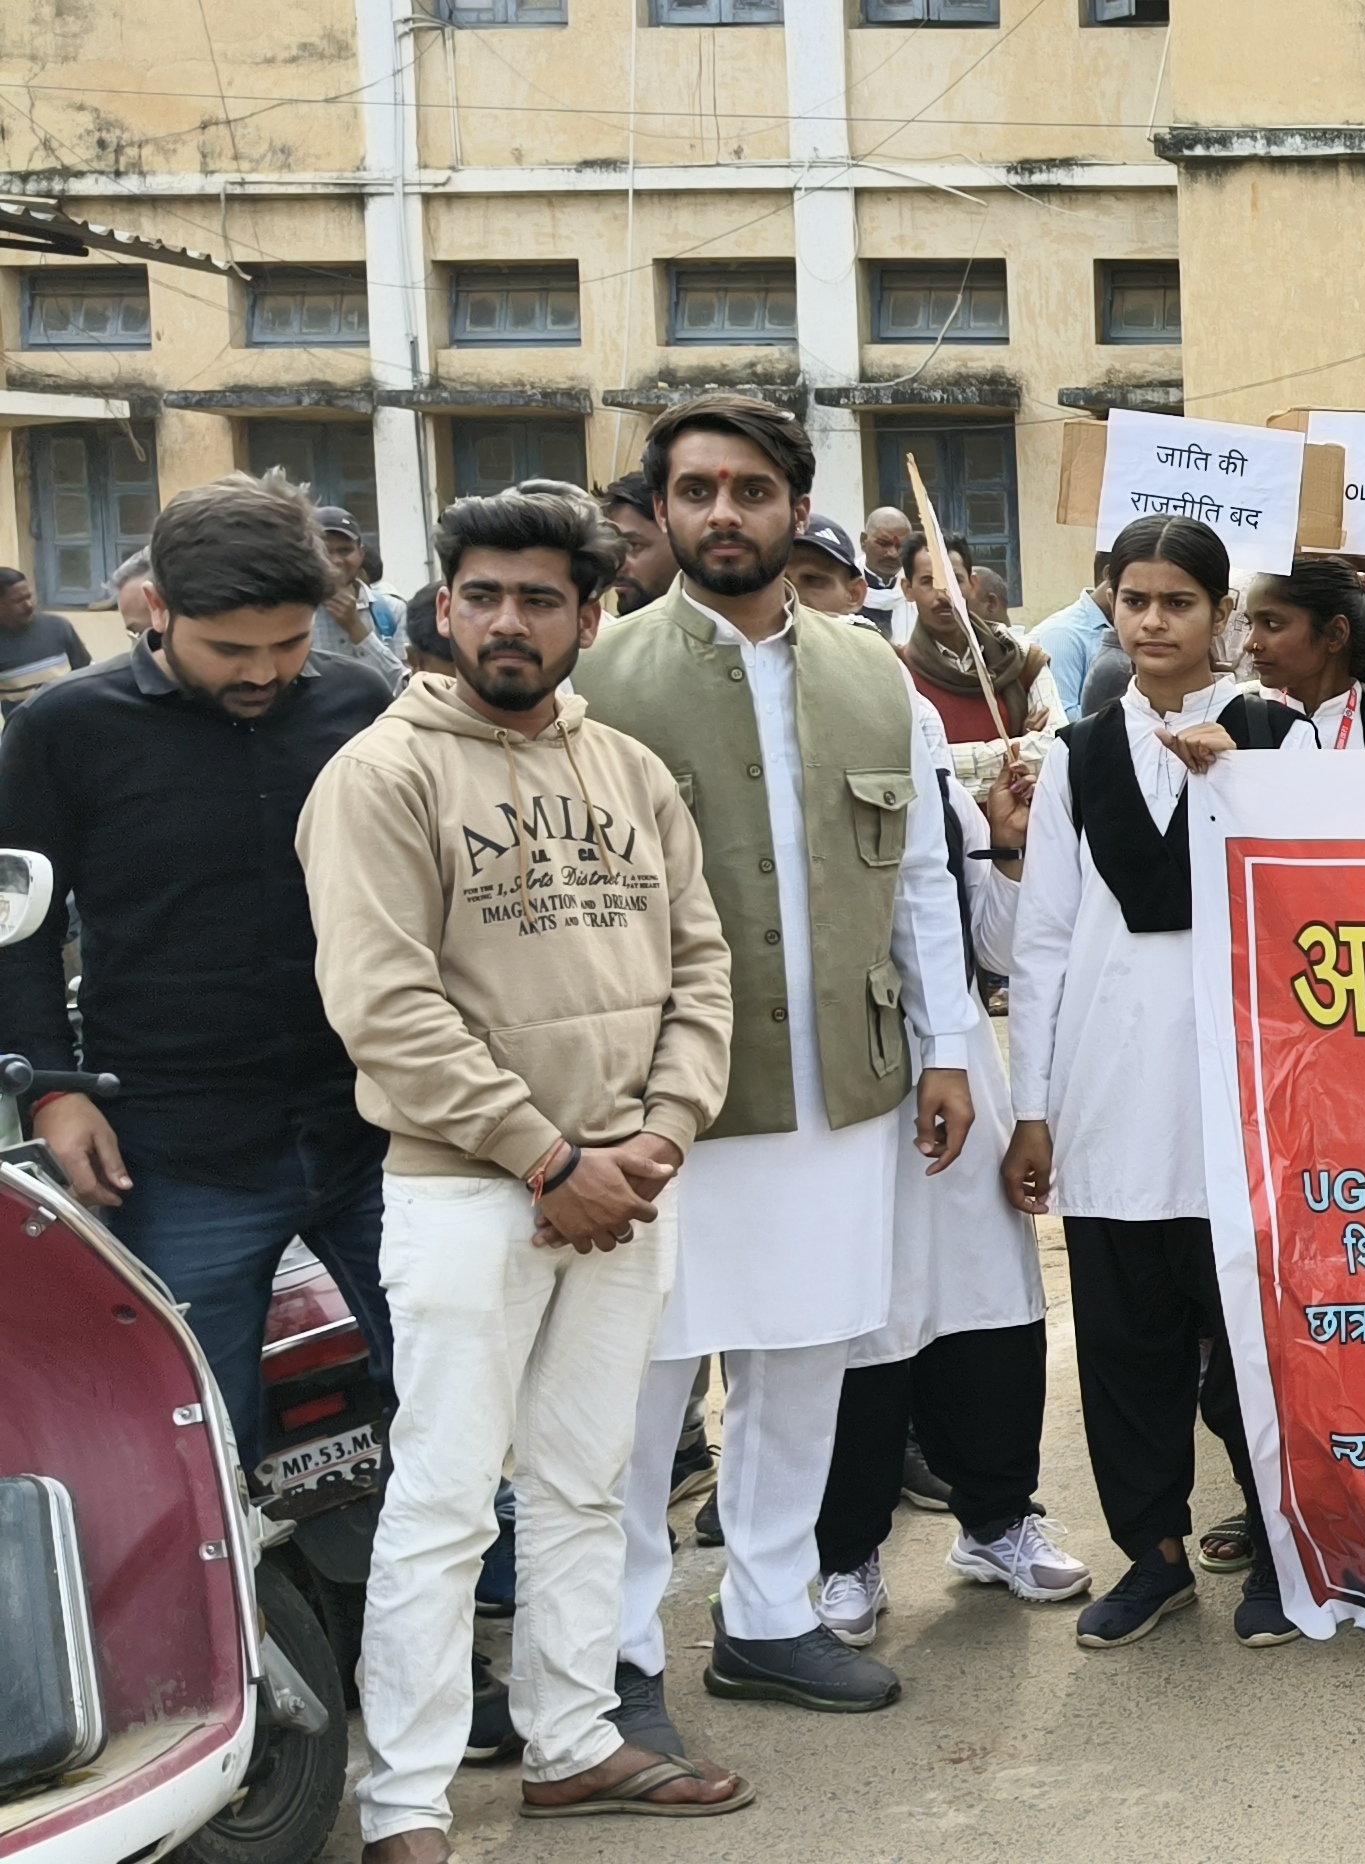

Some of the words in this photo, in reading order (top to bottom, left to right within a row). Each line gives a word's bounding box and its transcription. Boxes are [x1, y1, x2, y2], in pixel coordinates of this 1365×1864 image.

[1156, 442, 1212, 471] जाति
[1218, 447, 1249, 477] की
[1131, 492, 1224, 523] राजनीति
[463, 794, 637, 877] AMIRI
[510, 868, 553, 893] Arts
[561, 865, 620, 887] District
[482, 894, 577, 924] IMAGNATION
[580, 900, 596, 909] AND
[603, 893, 647, 911] DREAMS
[564, 916, 579, 926] AND
[583, 912, 628, 928] CRAFTS
